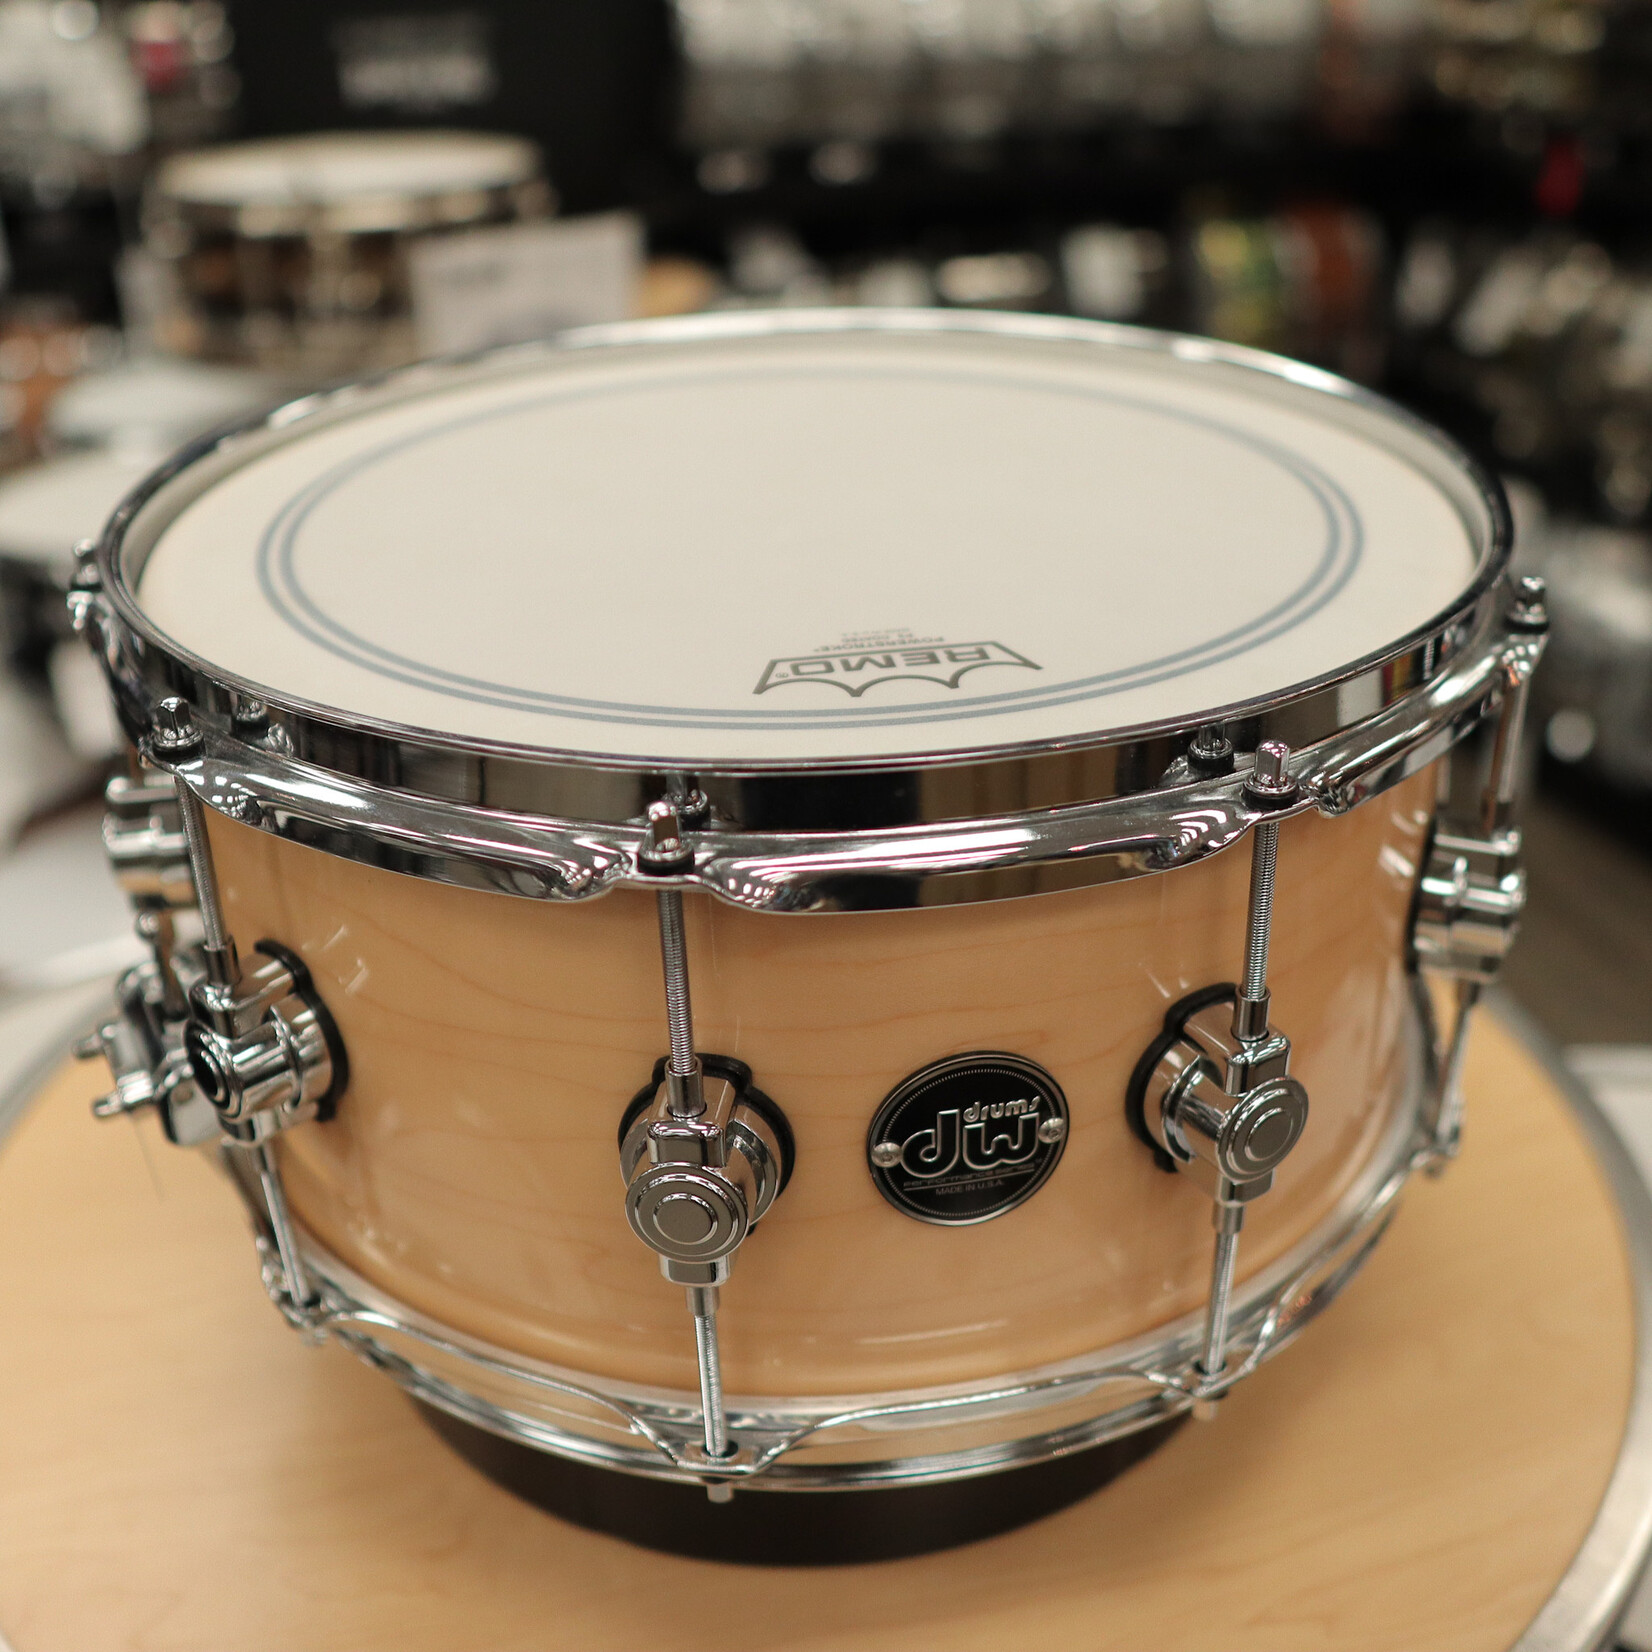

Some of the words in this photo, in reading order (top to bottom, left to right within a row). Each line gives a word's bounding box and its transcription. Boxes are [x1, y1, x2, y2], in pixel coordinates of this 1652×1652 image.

[789, 647, 991, 676] REMO
[963, 1095, 1041, 1123] drums
[900, 1108, 1040, 1179] dw
[935, 1185, 963, 1196] MADE
[965, 1184, 976, 1192] IN
